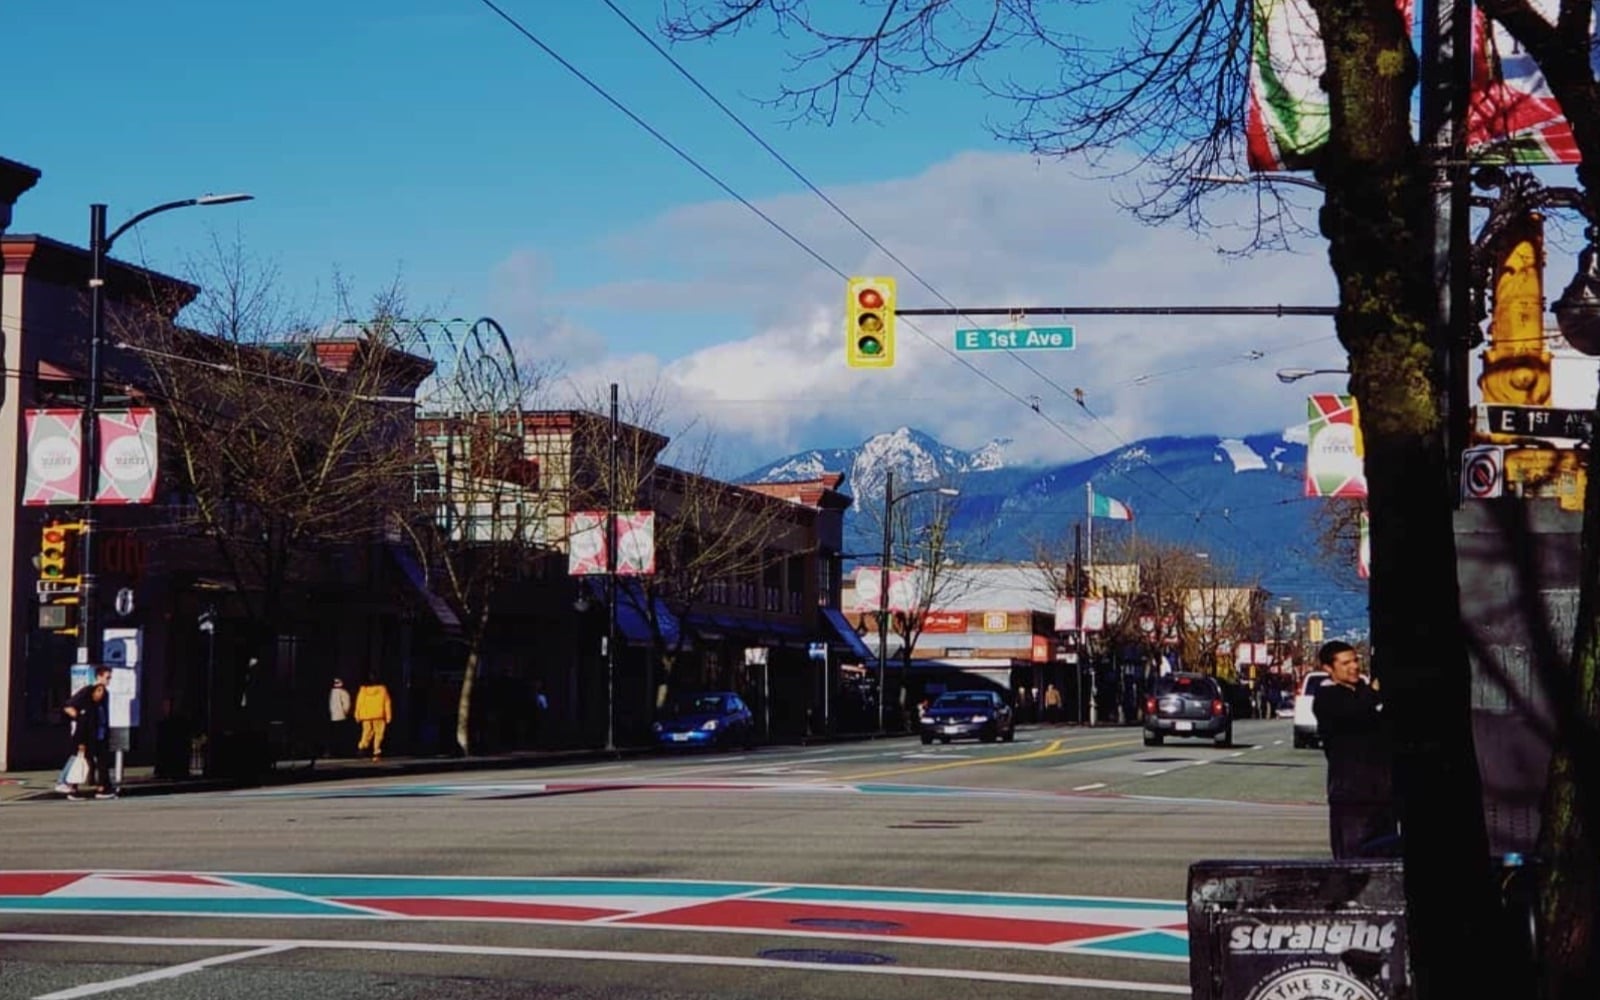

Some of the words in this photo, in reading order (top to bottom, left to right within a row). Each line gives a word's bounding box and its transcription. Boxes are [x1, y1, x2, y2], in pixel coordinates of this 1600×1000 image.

[965, 331, 979, 347] E
[988, 331, 1017, 347] 1st
[1025, 330, 1063, 346] Ave
[1501, 410, 1516, 431] E
[1528, 411, 1550, 432] 1ST
[1229, 920, 1397, 953] straight
[1274, 978, 1313, 999] THE
[1321, 978, 1366, 1000] STR
